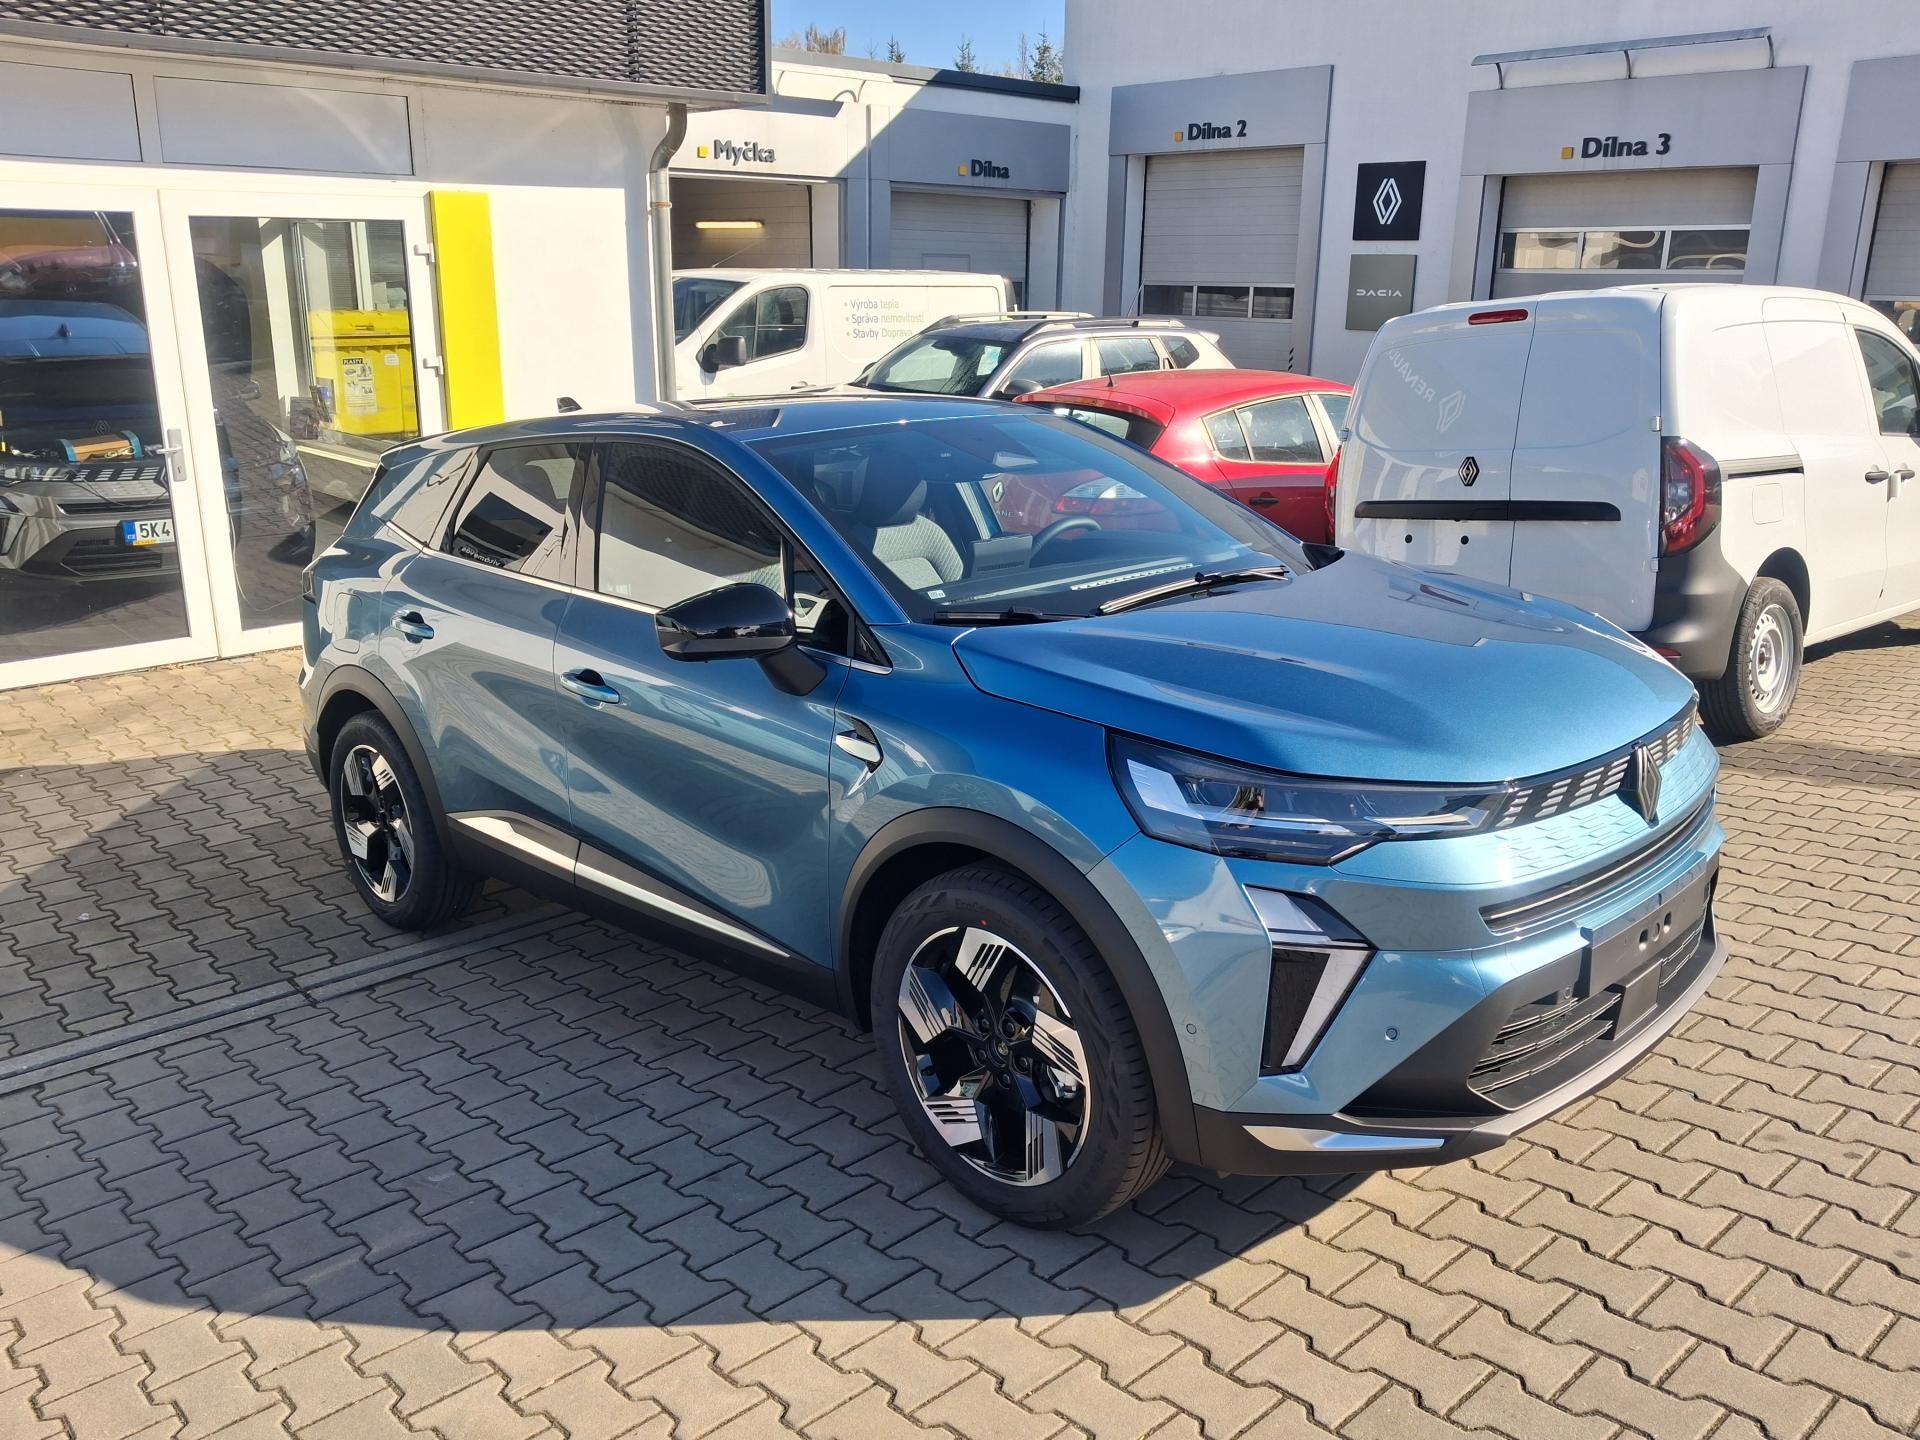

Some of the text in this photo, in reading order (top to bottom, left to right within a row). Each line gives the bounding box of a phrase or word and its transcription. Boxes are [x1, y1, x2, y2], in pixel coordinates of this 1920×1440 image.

[1187, 119, 1247, 141] Dílna 2
[713, 139, 777, 166] Myčka
[1581, 132, 1672, 159] Dílna 3
[970, 159, 1011, 179] Dílna
[1355, 288, 1403, 297] DACIA
[849, 298, 878, 311] Výroba
[851, 313, 879, 325] Správa
[852, 328, 913, 340] Stavby Doprava
[139, 521, 171, 538] 5K4
